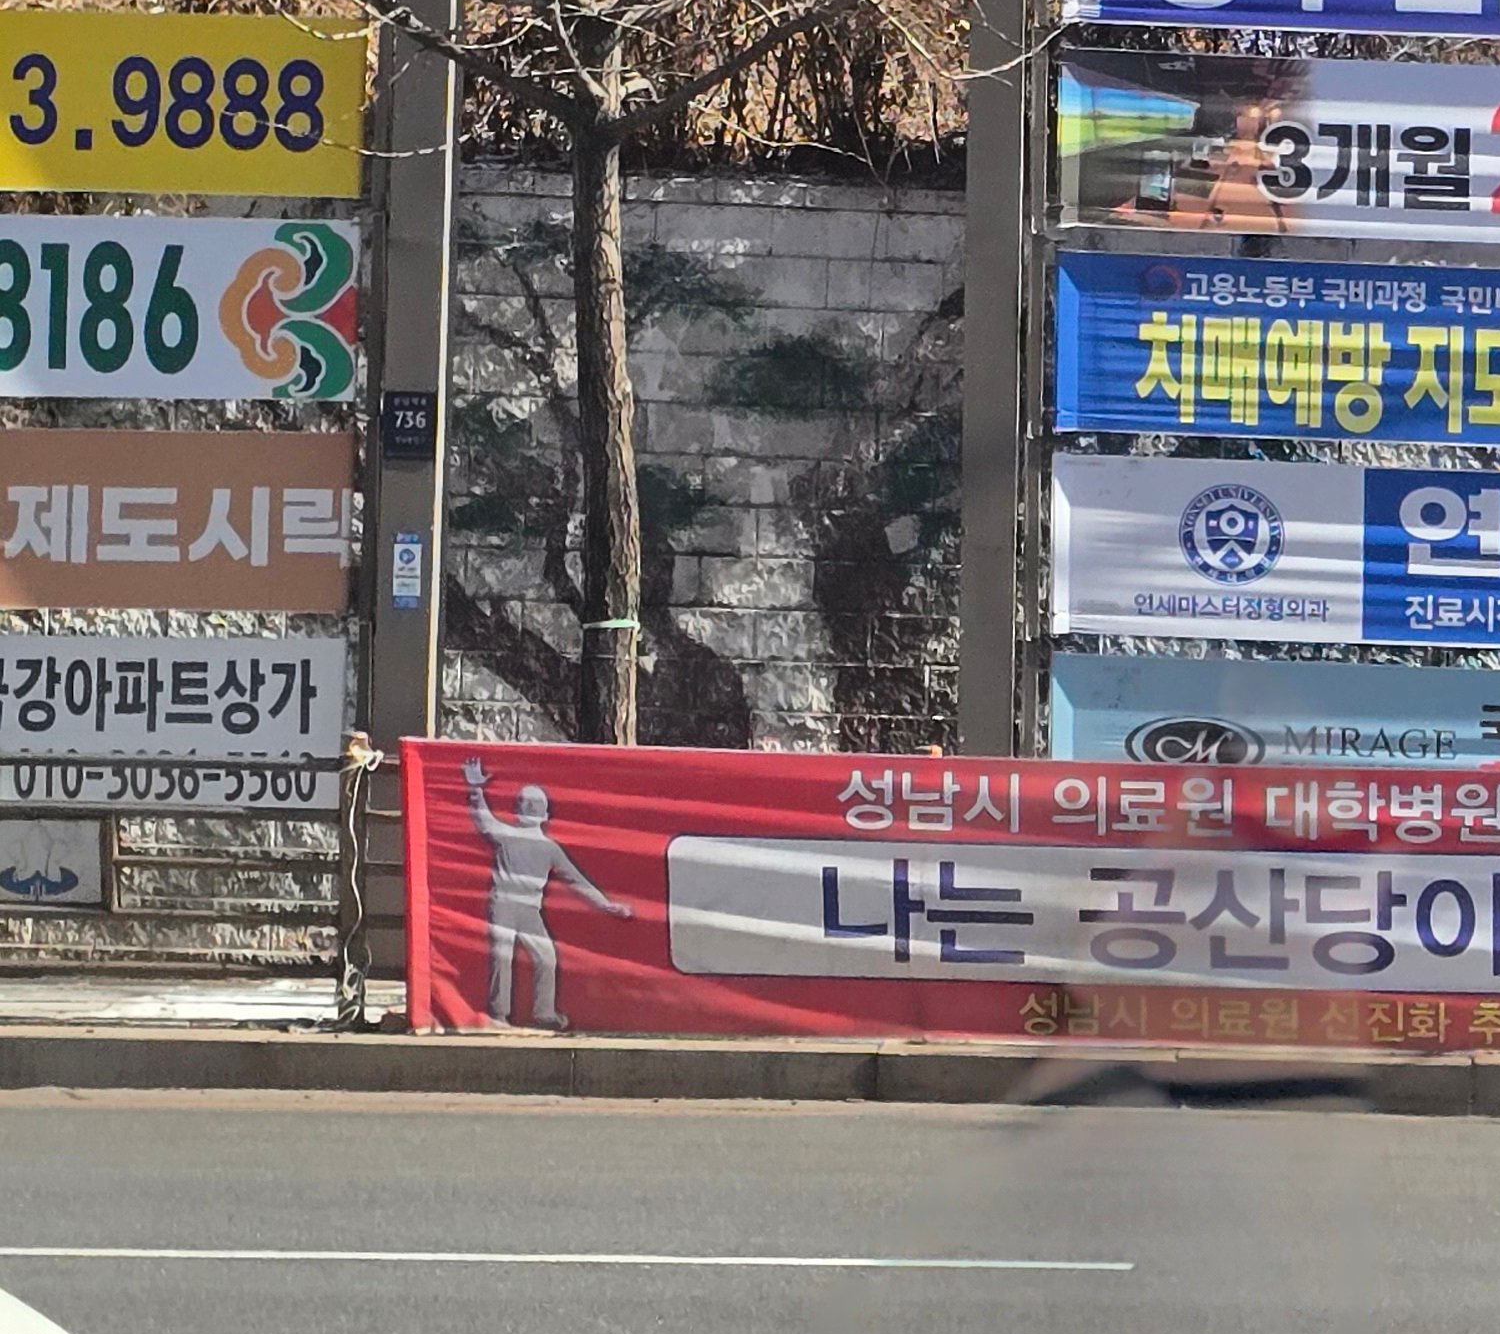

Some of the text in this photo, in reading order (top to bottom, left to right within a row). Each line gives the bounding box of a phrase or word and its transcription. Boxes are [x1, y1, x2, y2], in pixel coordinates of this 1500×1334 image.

[8, 53, 325, 153] 3.9888
[1260, 123, 1471, 212] 3개월
[0, 239, 200, 374] 8186
[1183, 272, 1316, 308] 고용노동부
[1321, 278, 1426, 313] 국비과정
[1135, 311, 1390, 433] 치매예방
[394, 411, 426, 429] 736
[1134, 593, 1329, 623] 연세마스터정형외과
[1283, 724, 1458, 761] MIRAGE
[838, 770, 1021, 833] 성남시
[1052, 774, 1233, 838] 의료원
[822, 857, 1034, 964] 나는
[1019, 992, 1147, 1036] 성남시
[1170, 997, 1297, 1039] 의료원
